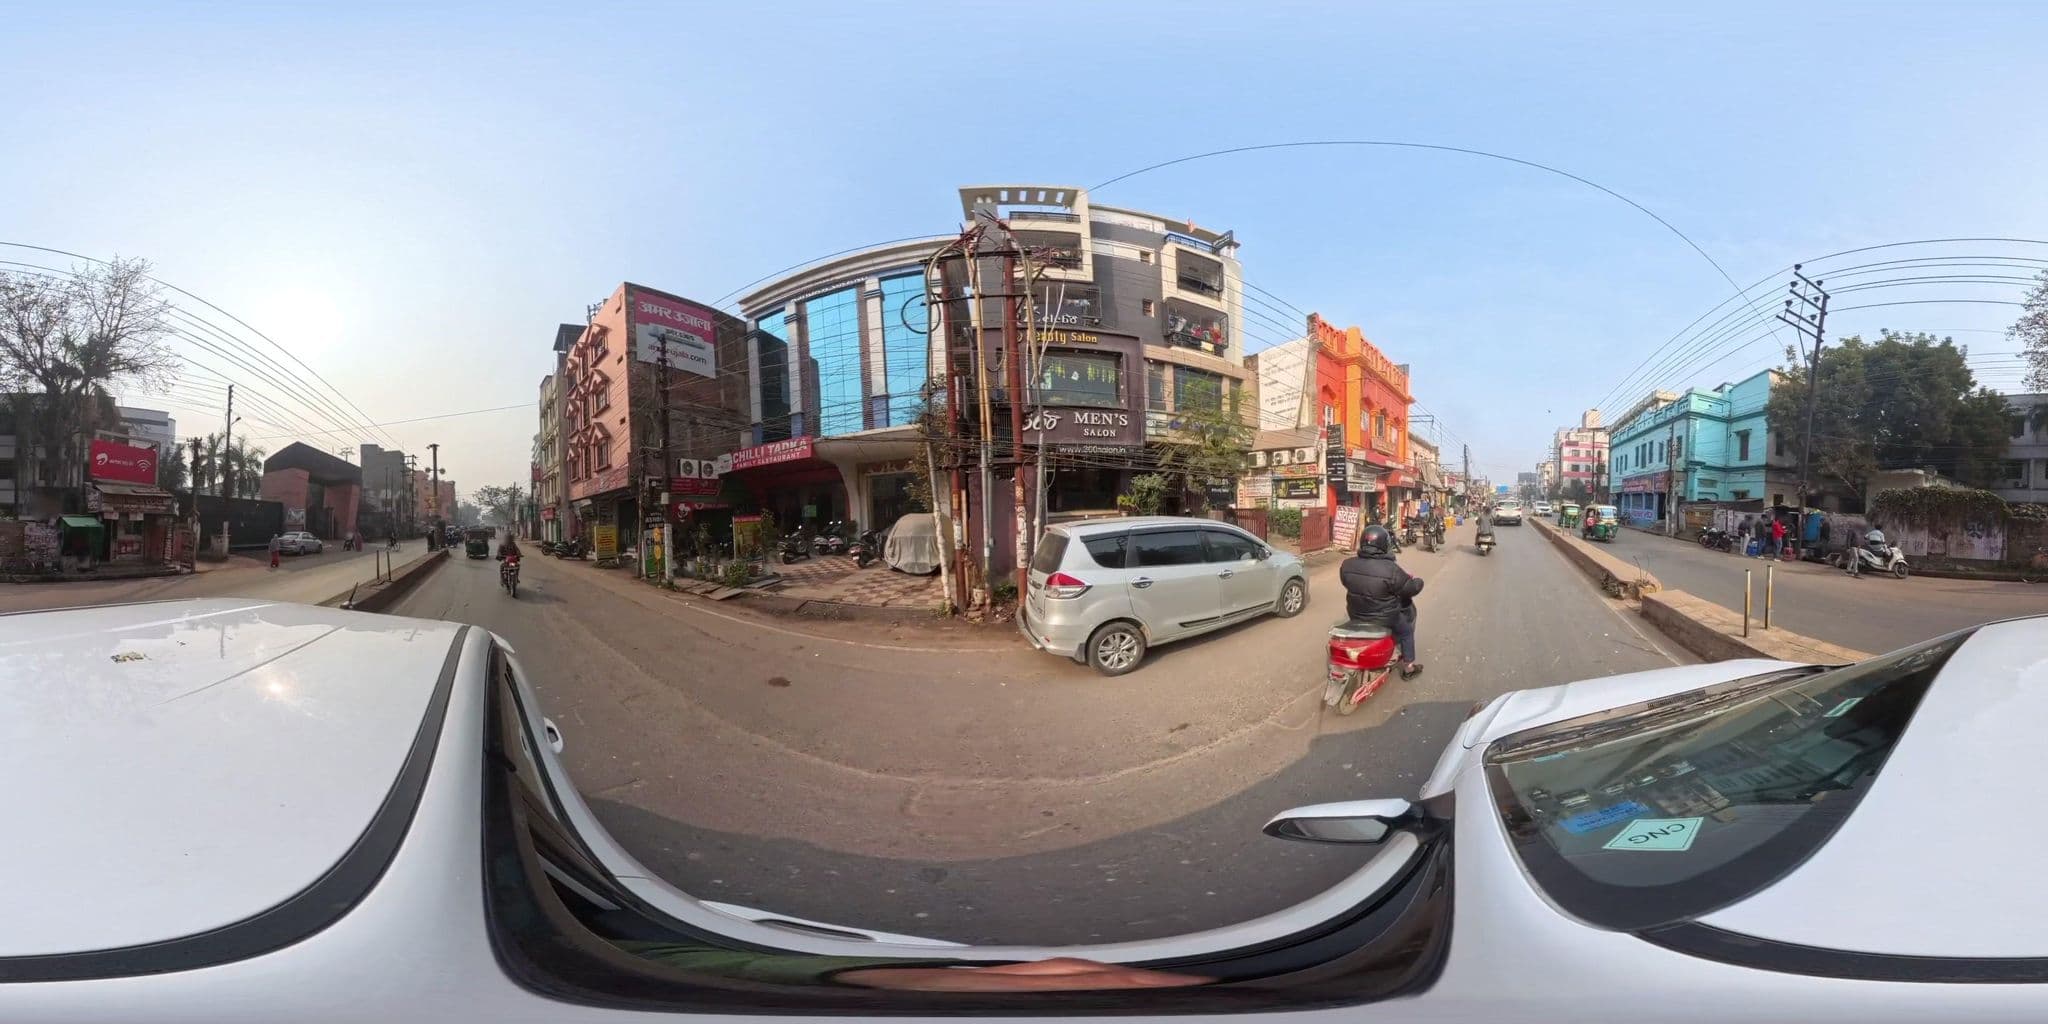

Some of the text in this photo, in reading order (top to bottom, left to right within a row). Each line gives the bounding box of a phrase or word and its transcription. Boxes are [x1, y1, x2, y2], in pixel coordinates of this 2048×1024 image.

[639, 301, 712, 332] अमर उजाला
[1071, 332, 1098, 343] Salon
[1073, 411, 1129, 427] MEN'S
[1083, 428, 1117, 438] SALON
[732, 446, 766, 464] CHILLI
[1628, 823, 1686, 845] CNG
